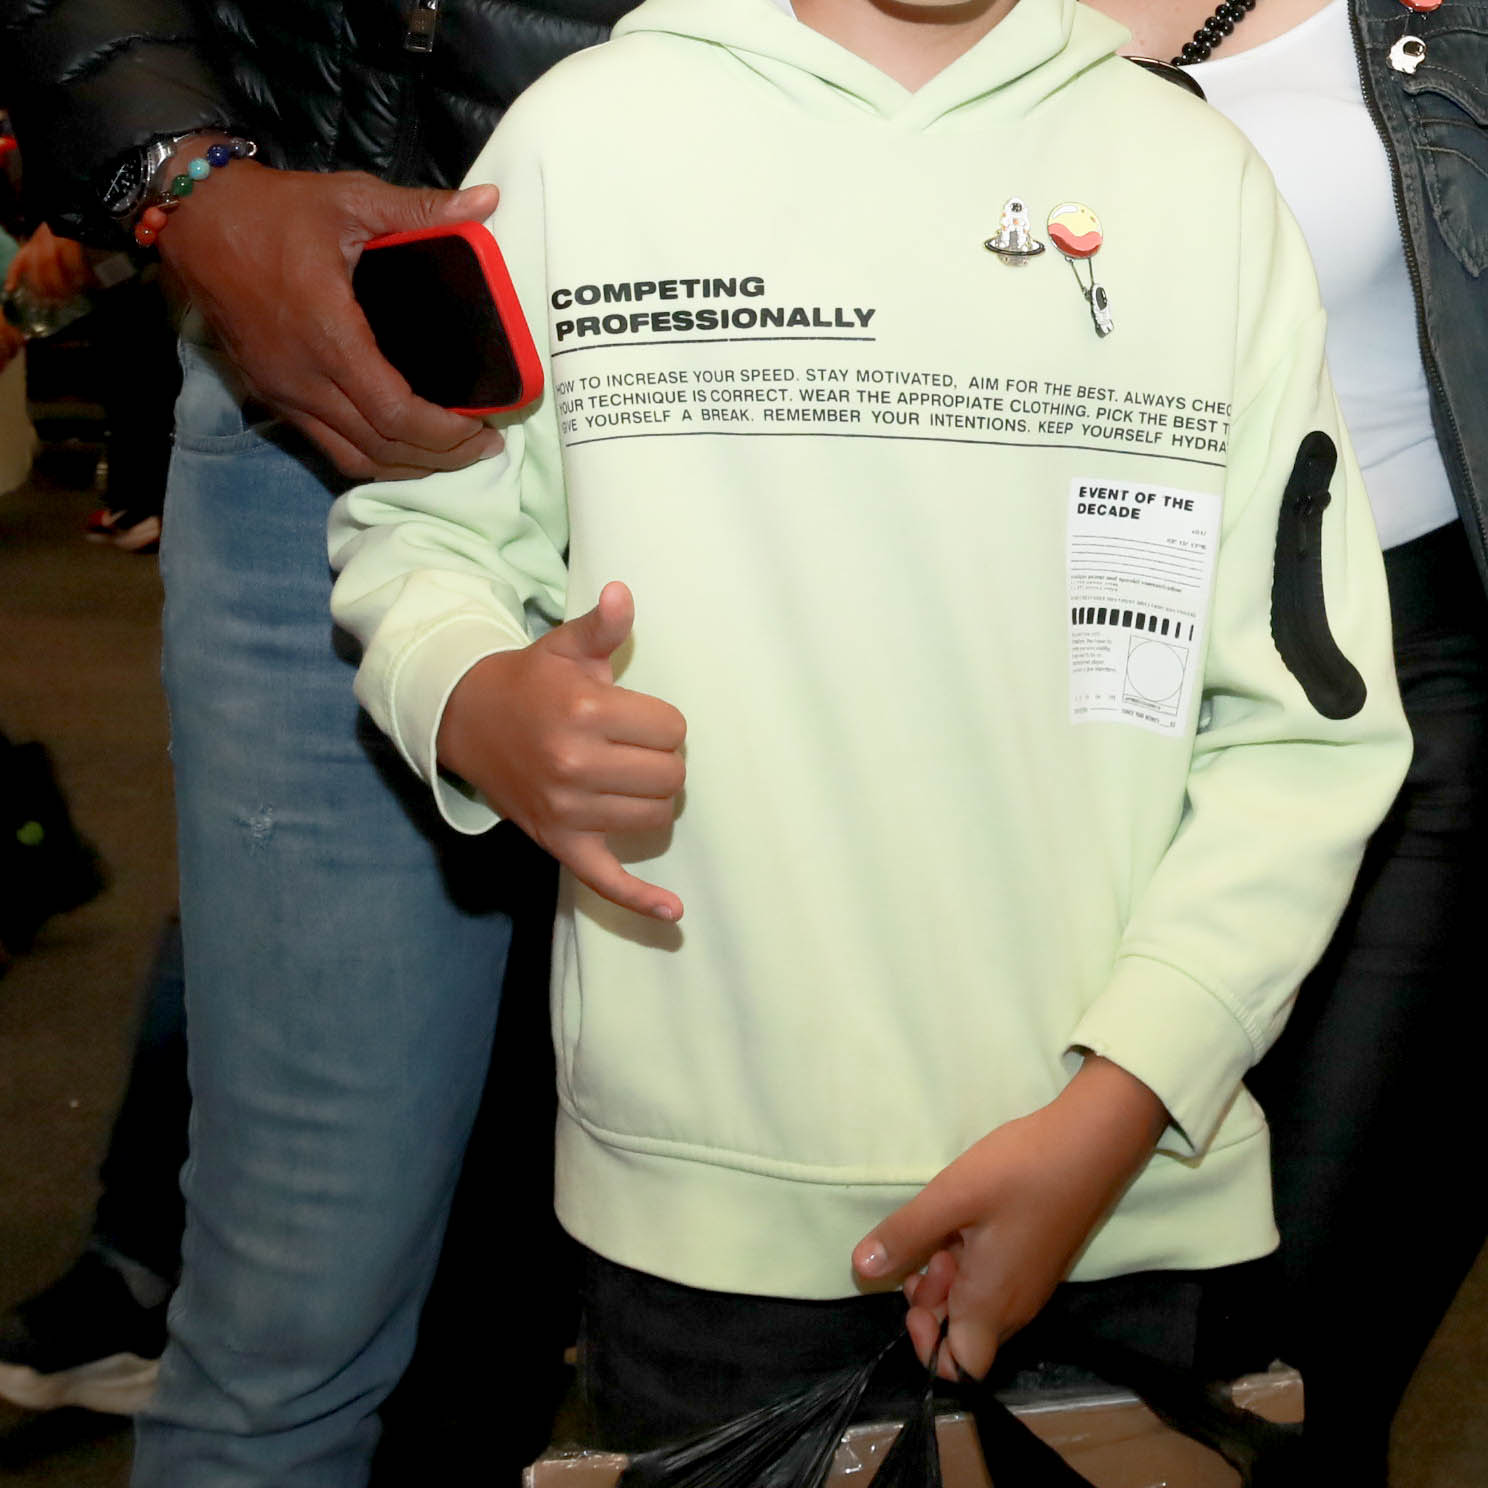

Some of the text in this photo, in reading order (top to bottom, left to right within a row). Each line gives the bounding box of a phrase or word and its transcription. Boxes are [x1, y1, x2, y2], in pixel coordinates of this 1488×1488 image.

[551, 276, 766, 310] COMPETING
[555, 307, 876, 342] PROFESSIONALLY
[579, 375, 601, 391] TO
[607, 370, 688, 388] INCREASE
[693, 369, 736, 384] YOUR
[740, 368, 800, 383] SPEED.
[805, 368, 850, 383] STAY
[856, 369, 958, 389] MOTIVATED,
[968, 376, 999, 391] AIM
[1006, 378, 1038, 394] FOR
[1044, 382, 1072, 397] THE
[1076, 385, 1119, 403] BEST.
[1123, 390, 1186, 410] ALWAYS
[585, 410, 672, 429] YOURSELF
[681, 409, 693, 422] A
[701, 408, 754, 422] BREAK.
[764, 408, 861, 423] REMEMBER
[871, 410, 920, 426] YOUR
[930, 413, 1031, 433] INTENTIONS.
[1038, 421, 1074, 435] KEEP
[1081, 424, 1163, 444] YOURSELF
[587, 390, 688, 410] TECHNIQUE
[692, 389, 707, 402] IS
[710, 388, 793, 403] CORRECT.
[799, 388, 850, 403] WEAR
[857, 390, 892, 404] THE
[897, 392, 1004, 412] APPROPIATE
[1009, 399, 1090, 418] CLOTHING.
[1096, 407, 1133, 423] PICK
[1138, 411, 1167, 427] THE
[1173, 415, 1218, 433] BEST
[1077, 502, 1142, 520] DECADE
[1078, 486, 1195, 512] EVENT OF THE
